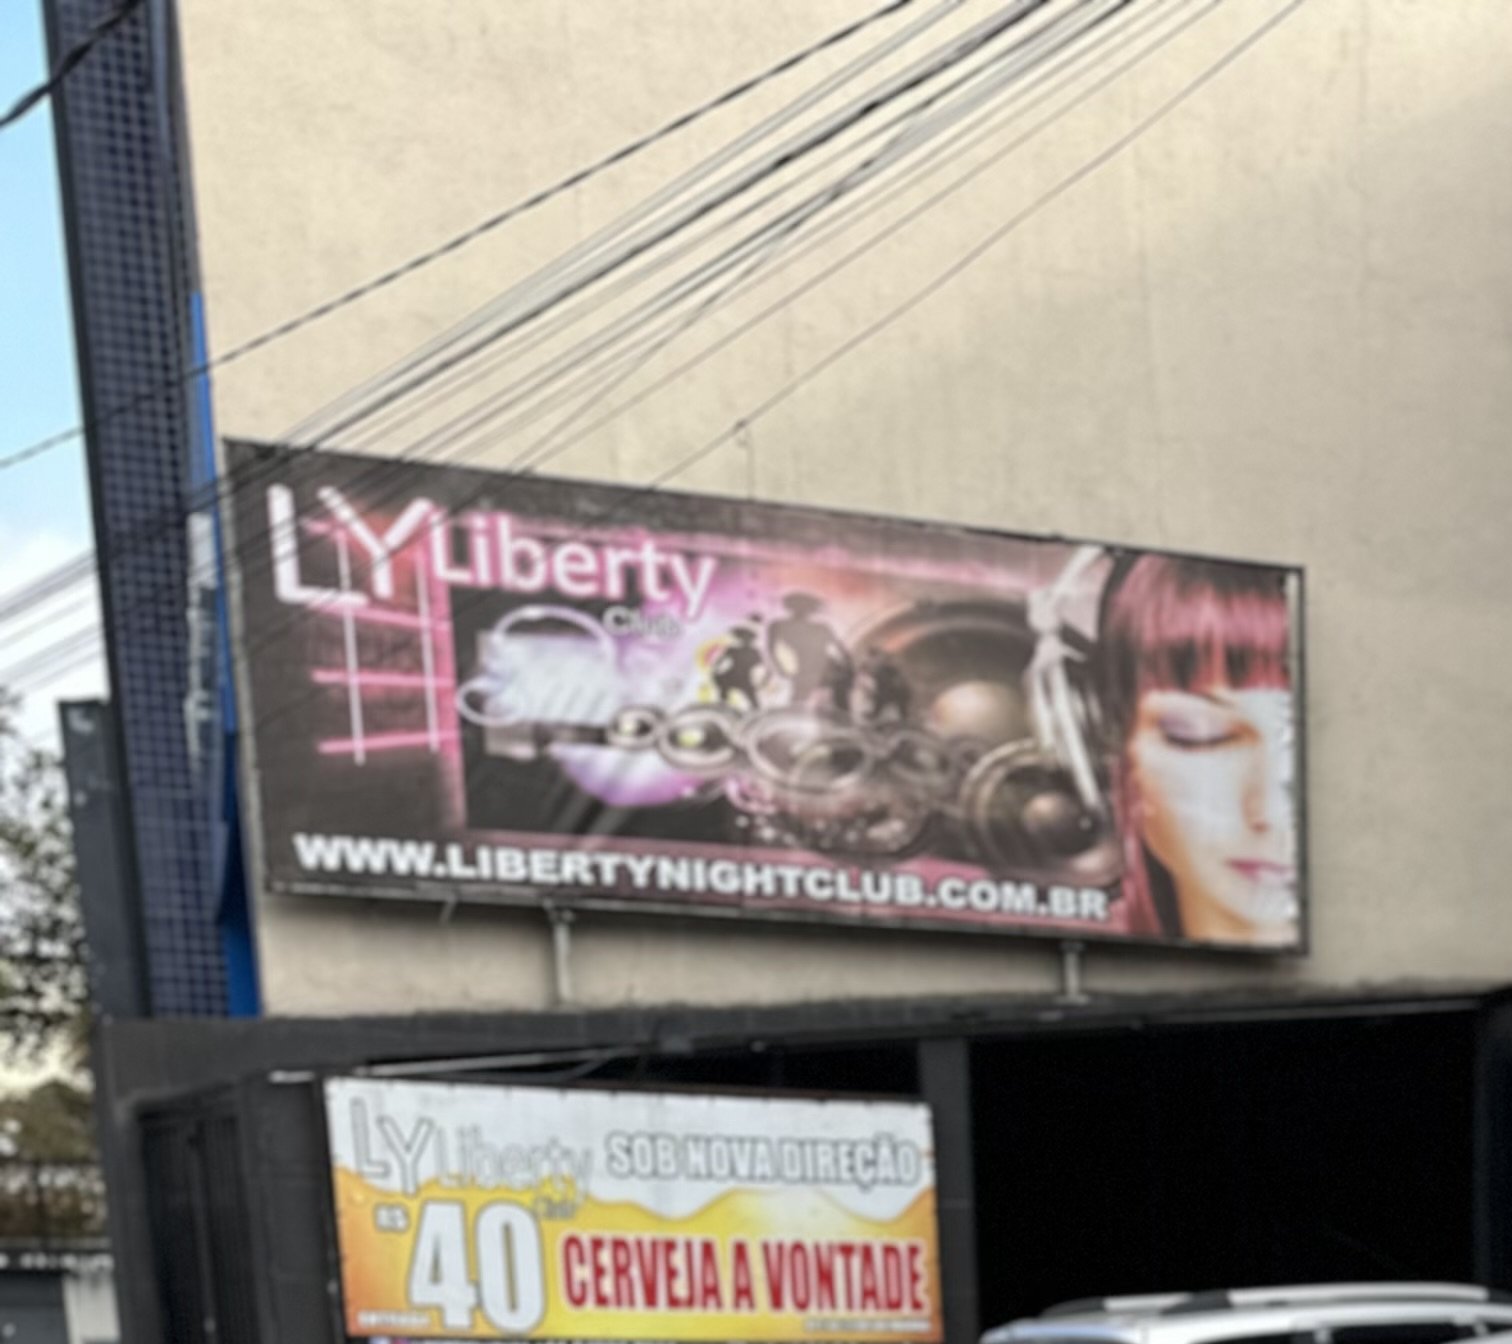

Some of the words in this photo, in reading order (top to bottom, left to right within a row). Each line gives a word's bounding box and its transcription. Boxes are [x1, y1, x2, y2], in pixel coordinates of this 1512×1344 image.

[267, 484, 434, 608] LY
[428, 511, 718, 617] Liberty
[293, 831, 1109, 919] WWW.LIBERTYNIGHTCLUB.COM.BR
[349, 1097, 435, 1196] LY
[605, 1130, 680, 1180] SOB
[682, 1134, 774, 1182] NOVA
[775, 1132, 921, 1194] DIREÇÃO
[409, 1199, 545, 1334] 40
[562, 1235, 722, 1309] CERVEJA
[731, 1239, 755, 1309] A
[762, 1240, 925, 1311] VONTADE
